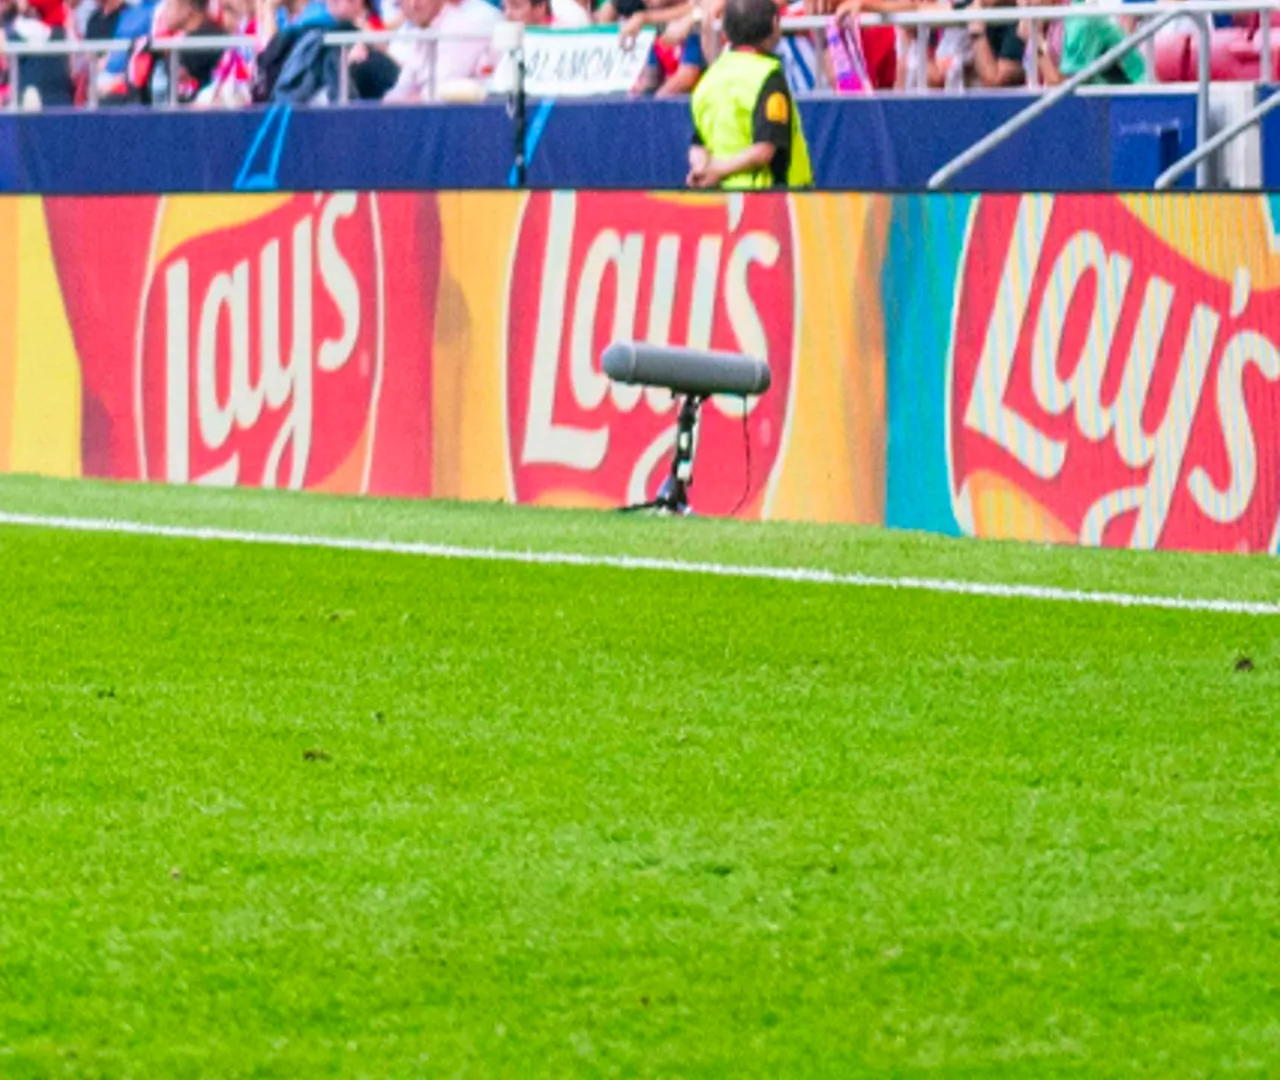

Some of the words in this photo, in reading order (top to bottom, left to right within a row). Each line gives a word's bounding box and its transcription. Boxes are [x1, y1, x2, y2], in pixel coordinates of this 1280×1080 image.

[165, 191, 361, 490] Lay's
[521, 190, 781, 510] Lay's
[963, 193, 1280, 549] Lay's
